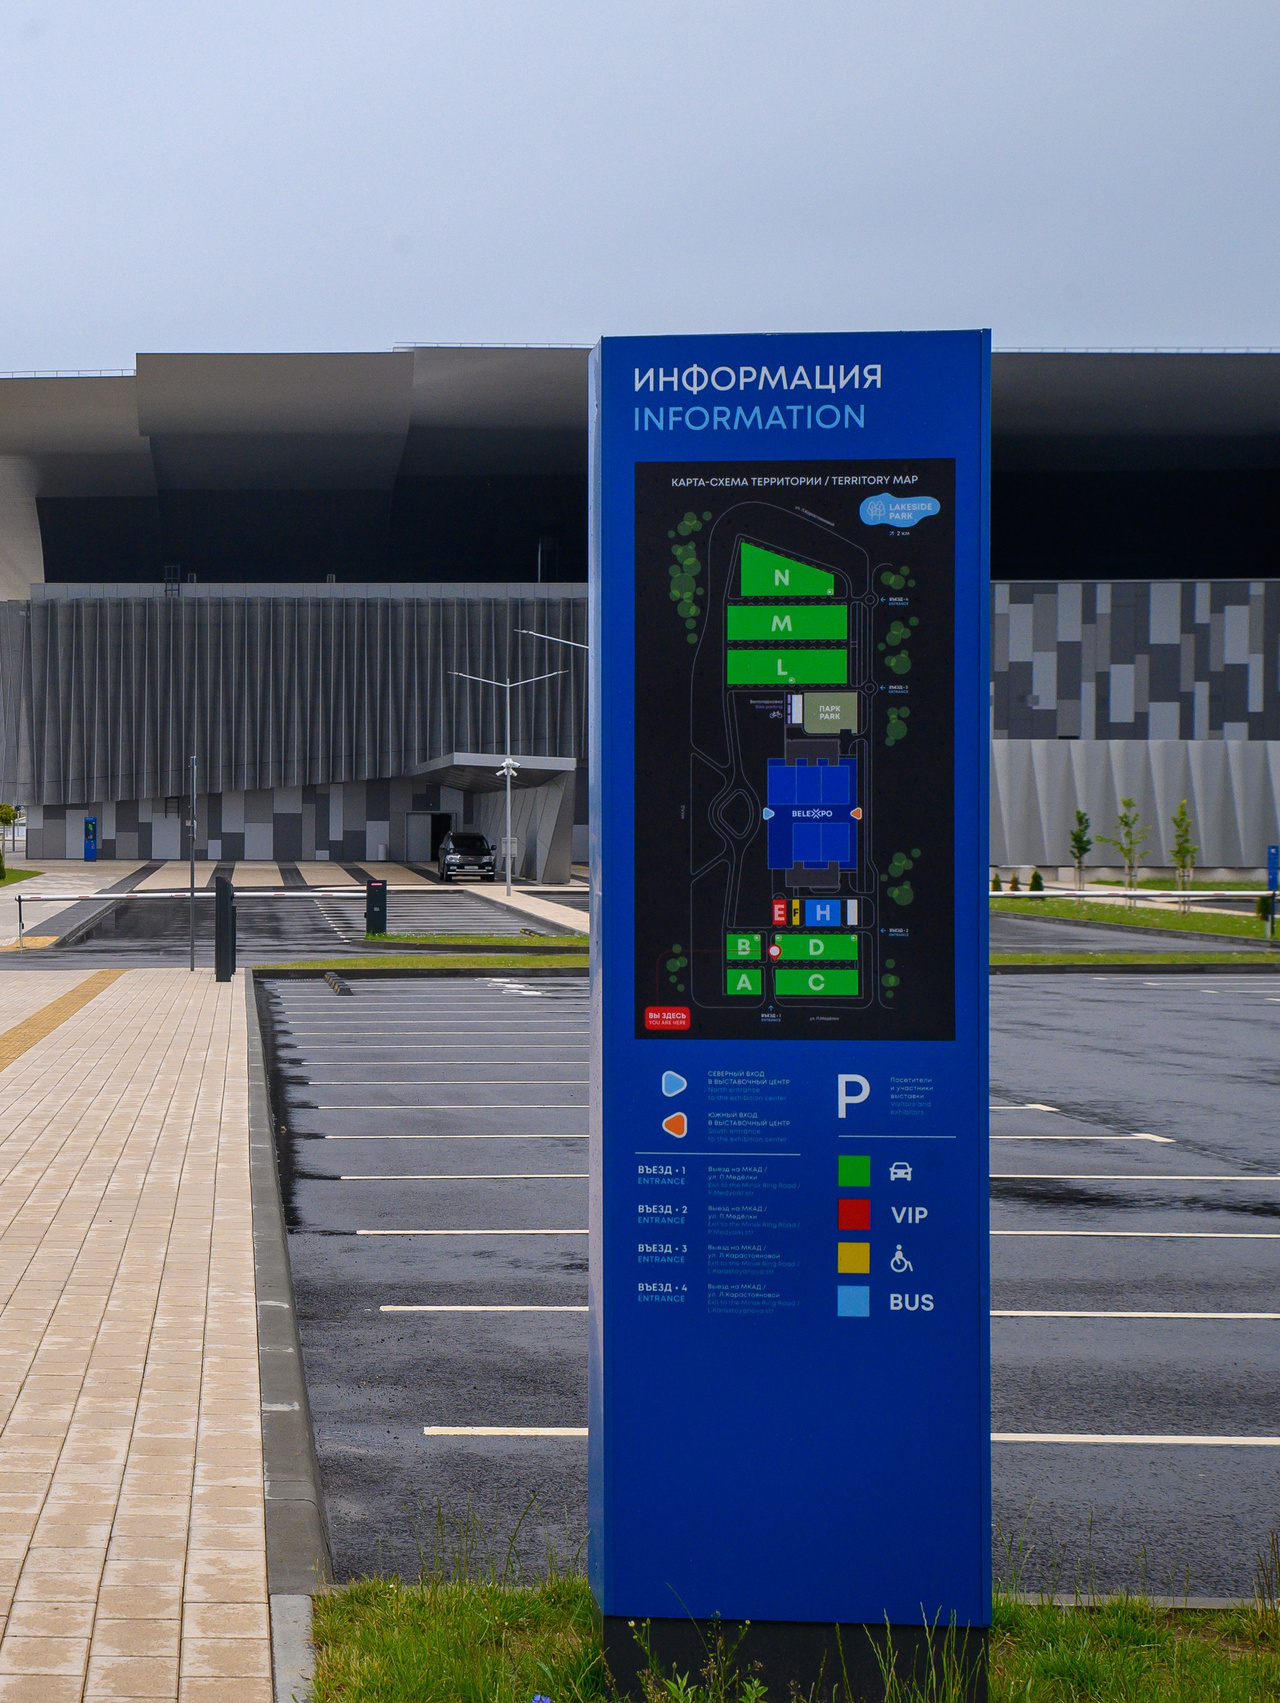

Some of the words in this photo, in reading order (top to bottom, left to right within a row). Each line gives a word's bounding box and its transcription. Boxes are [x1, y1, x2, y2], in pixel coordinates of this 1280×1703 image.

[634, 363, 882, 395] ИНФОРМАЦИЯ
[634, 404, 865, 431] INFORMATION
[671, 477, 749, 487] КАРТА-СХЕМА
[751, 476, 822, 486] ТЕРРИТОРИИ
[832, 475, 890, 485] TERRITORY
[893, 475, 919, 484] MAP
[889, 503, 933, 511] LAKESIDE
[889, 512, 913, 520] PARK
[775, 569, 789, 586] N
[771, 615, 792, 632] M
[777, 659, 788, 675] L
[792, 808, 833, 819] BELEXPO
[774, 904, 785, 921] E
[793, 908, 799, 917] F
[816, 904, 830, 921] H
[737, 938, 750, 955] B
[809, 939, 824, 955] D
[736, 973, 752, 991] A
[808, 974, 825, 991] C
[837, 1073, 871, 1118] P
[638, 1165, 672, 1175] ВЪЕЗД
[682, 1166, 686, 1175] 1
[638, 1177, 685, 1185] ENTRANCE
[638, 1205, 672, 1214] ВЪЕЗД
[682, 1205, 688, 1214] 2
[891, 1206, 928, 1224] VIP
[638, 1244, 672, 1253] ВЪЕЗД
[682, 1244, 688, 1253] 3
[638, 1283, 672, 1293] ВЪЕЗД
[682, 1284, 688, 1292] 4
[890, 1293, 935, 1312] BUS
